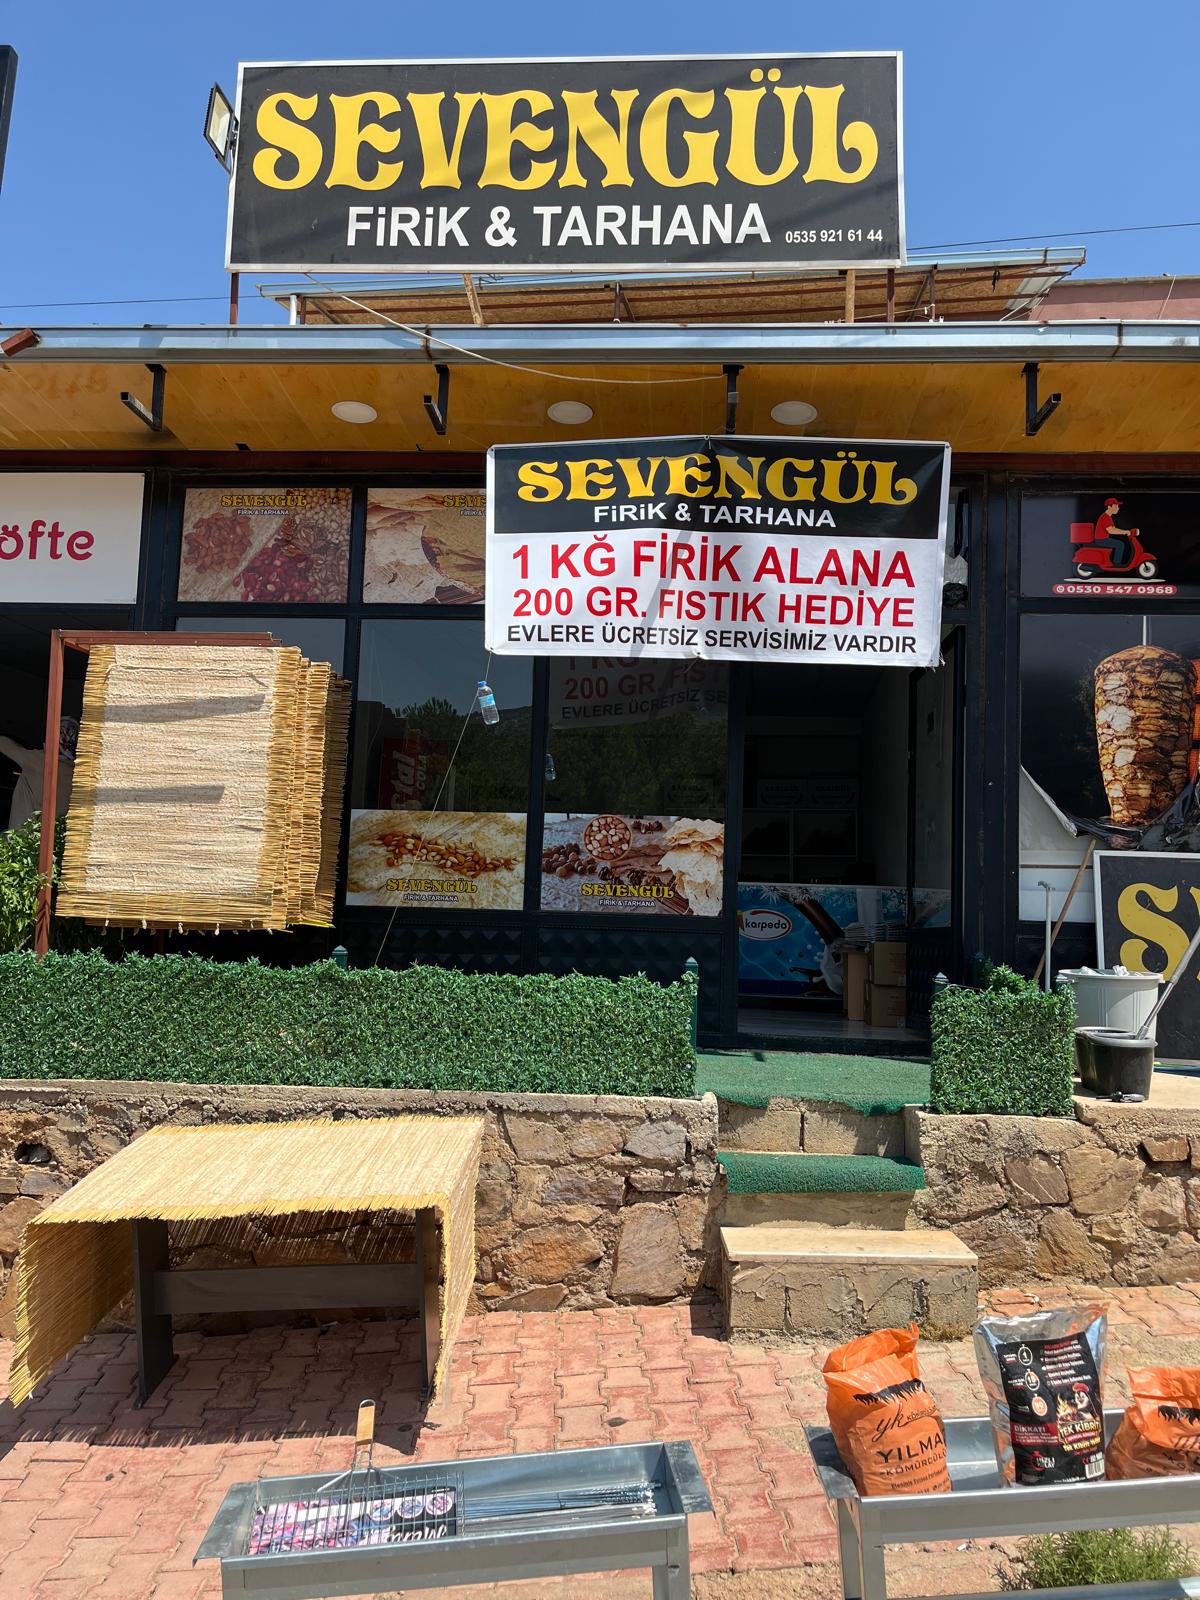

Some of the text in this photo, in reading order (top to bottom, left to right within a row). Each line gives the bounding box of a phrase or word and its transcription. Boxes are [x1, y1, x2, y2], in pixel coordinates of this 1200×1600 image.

[253, 67, 878, 191] SEVENGÜL
[484, 205, 517, 248] &
[533, 202, 771, 247] TARHANA
[785, 230, 816, 244] 0535
[819, 230, 843, 244] 921
[847, 229, 864, 243] 61
[866, 229, 884, 243] 44
[517, 451, 918, 505] SEVENGÜL
[674, 503, 691, 522] &
[699, 504, 836, 528] TARHANA
[512, 532, 915, 588] 1 KĞ FİRİK ALANA
[1066, 585, 1173, 594] 0530 547 0968
[512, 586, 914, 627] 200 GR. FISTIK HEDİYE
[507, 624, 917, 653] EVLERE ÜCRETSİZ SERVİSİMİZ VARDIR
[562, 703, 622, 720] EVLERE
[386, 878, 478, 893] SEVENGÜL
[581, 882, 674, 899] SEVENGÜL
[745, 918, 788, 932] karpedo
